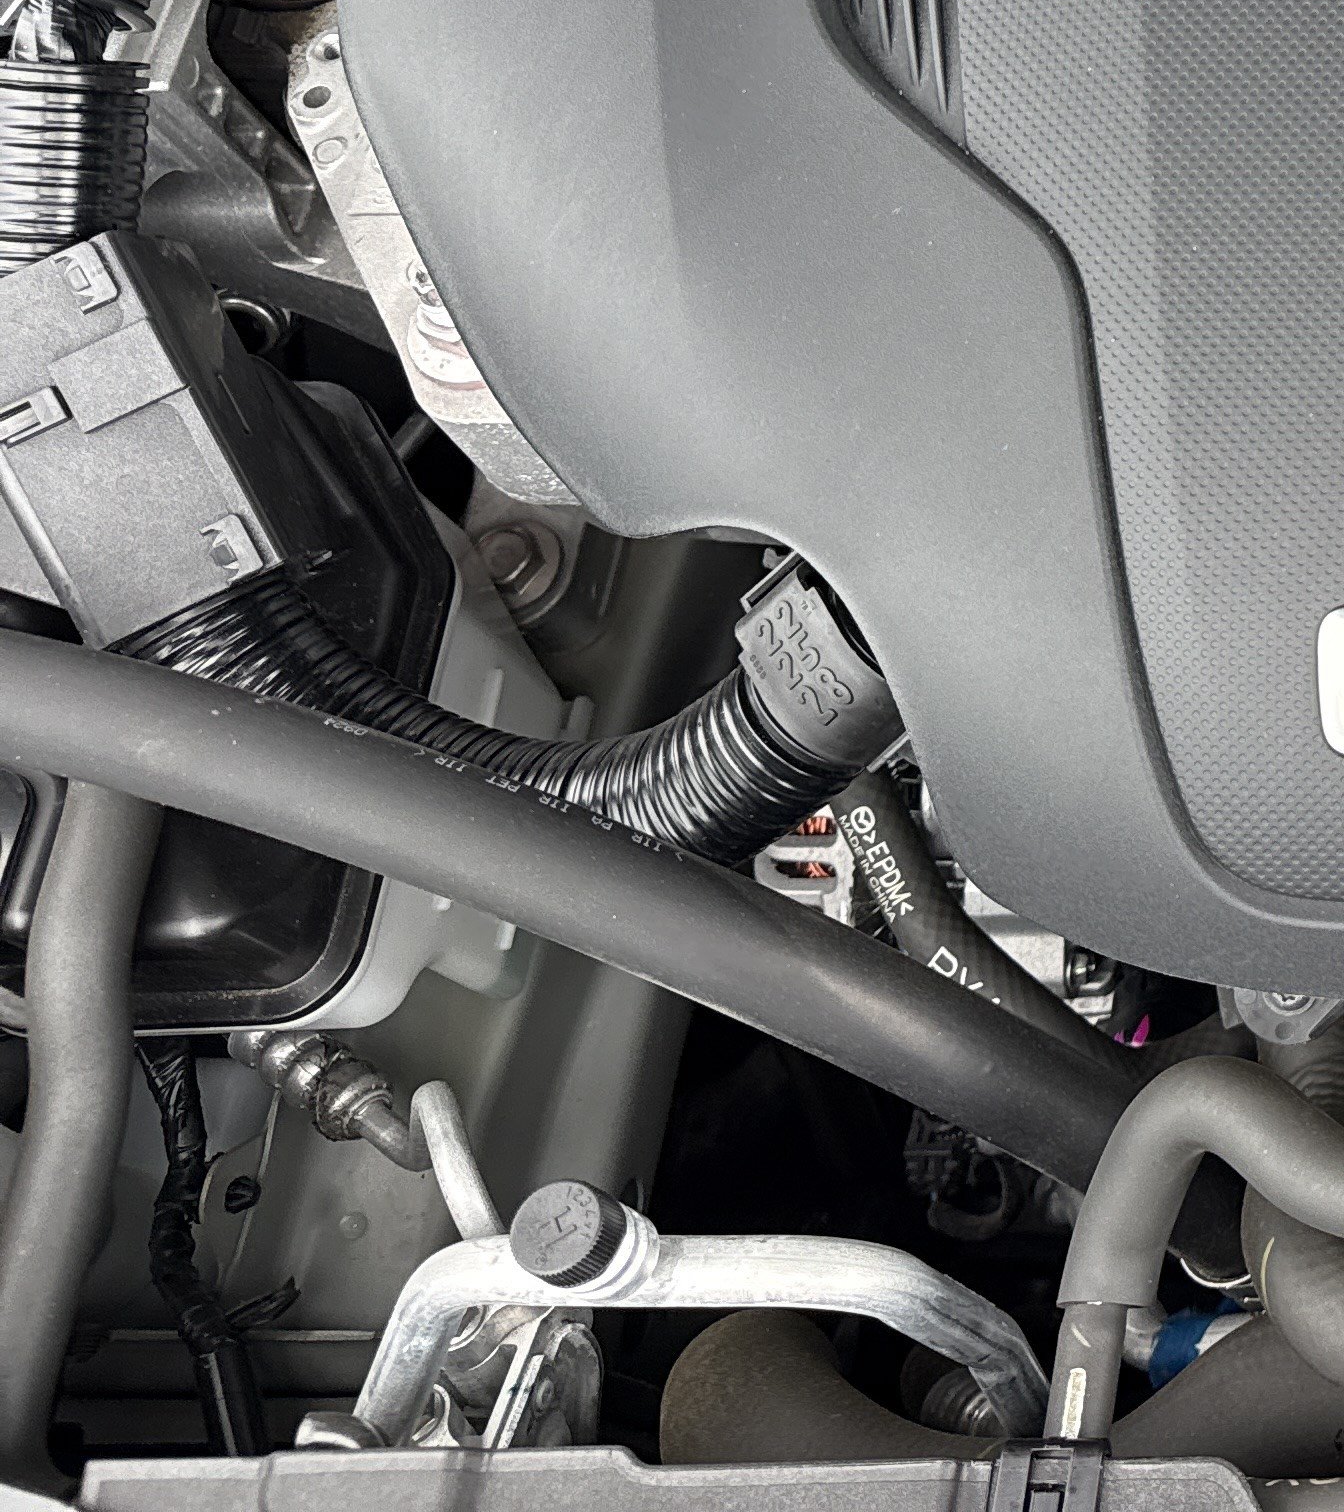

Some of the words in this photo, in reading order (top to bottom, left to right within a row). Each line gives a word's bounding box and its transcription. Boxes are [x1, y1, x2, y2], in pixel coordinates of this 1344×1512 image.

[755, 599, 803, 657] 22
[777, 630, 821, 691] 25
[800, 666, 855, 727] 28
[838, 814, 866, 857] MADE
[859, 855, 875, 876] IN
[867, 875, 897, 924] CHINA
